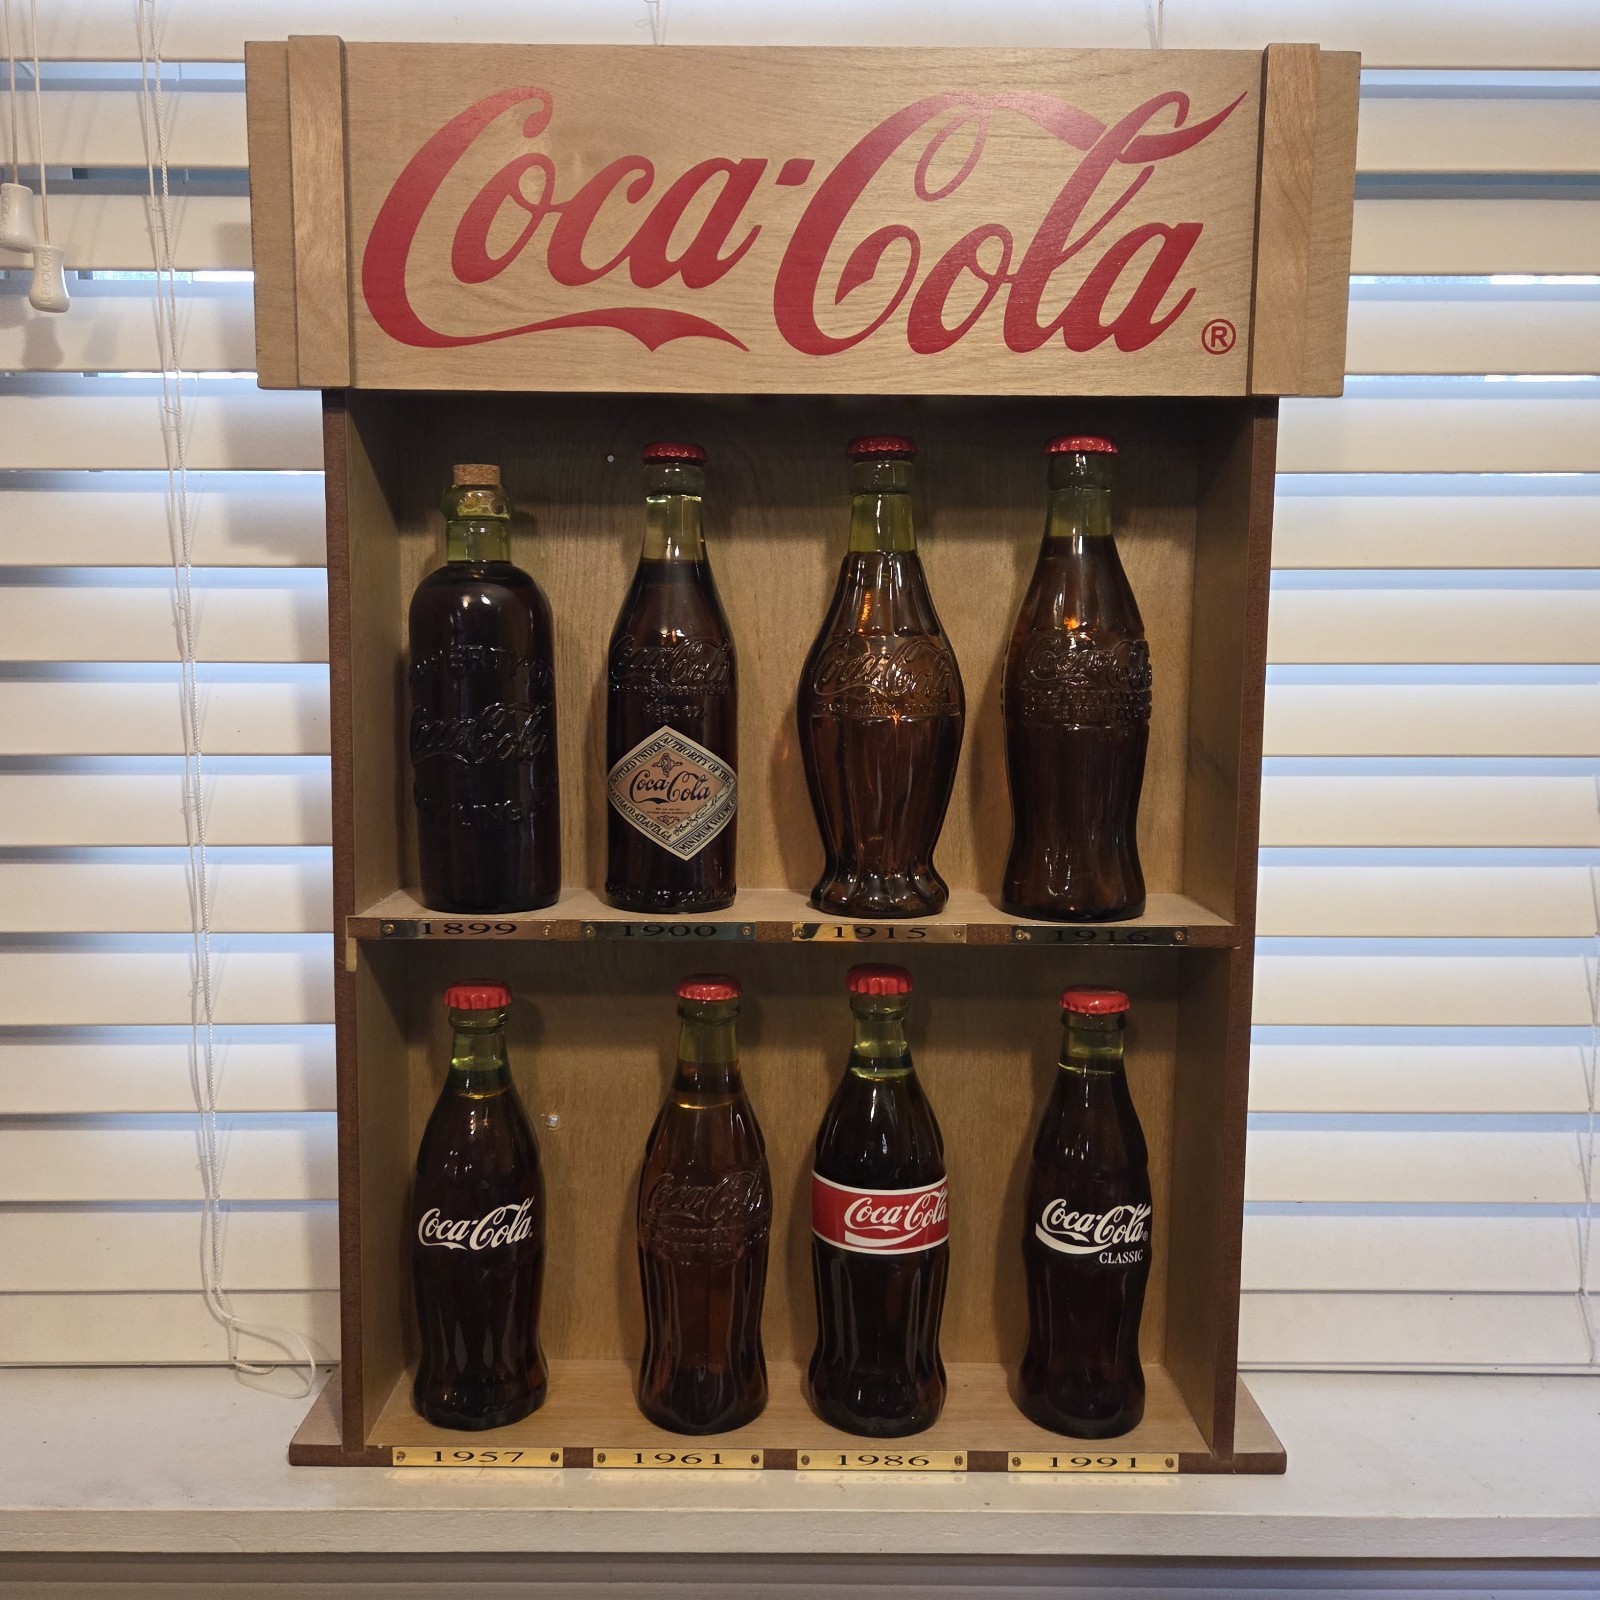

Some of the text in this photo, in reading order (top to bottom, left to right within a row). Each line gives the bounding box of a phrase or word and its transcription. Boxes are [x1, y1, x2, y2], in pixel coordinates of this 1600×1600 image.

[361, 86, 1247, 356] Coca-Cola
[636, 740, 666, 767] UNDER
[660, 737, 710, 767] AUTHORITY
[707, 761, 720, 775] OF
[629, 769, 711, 804] Coca-Cola
[679, 824, 714, 852] MINIMUM
[710, 804, 731, 826] VOLUME
[419, 922, 517, 935] 1899
[622, 924, 717, 937] 1900
[833, 926, 927, 939] 1915
[1053, 930, 1152, 943] 1916
[844, 1186, 948, 1232] Coca-Cola
[418, 1195, 534, 1250] Coca-Cola
[1042, 1198, 1151, 1244] Coca-Cola
[1099, 1249, 1144, 1264] CLASSIC
[432, 1450, 524, 1462] 1957
[633, 1452, 725, 1465] 1961
[837, 1454, 930, 1467] 1986
[1049, 1456, 1140, 1469] 1991
